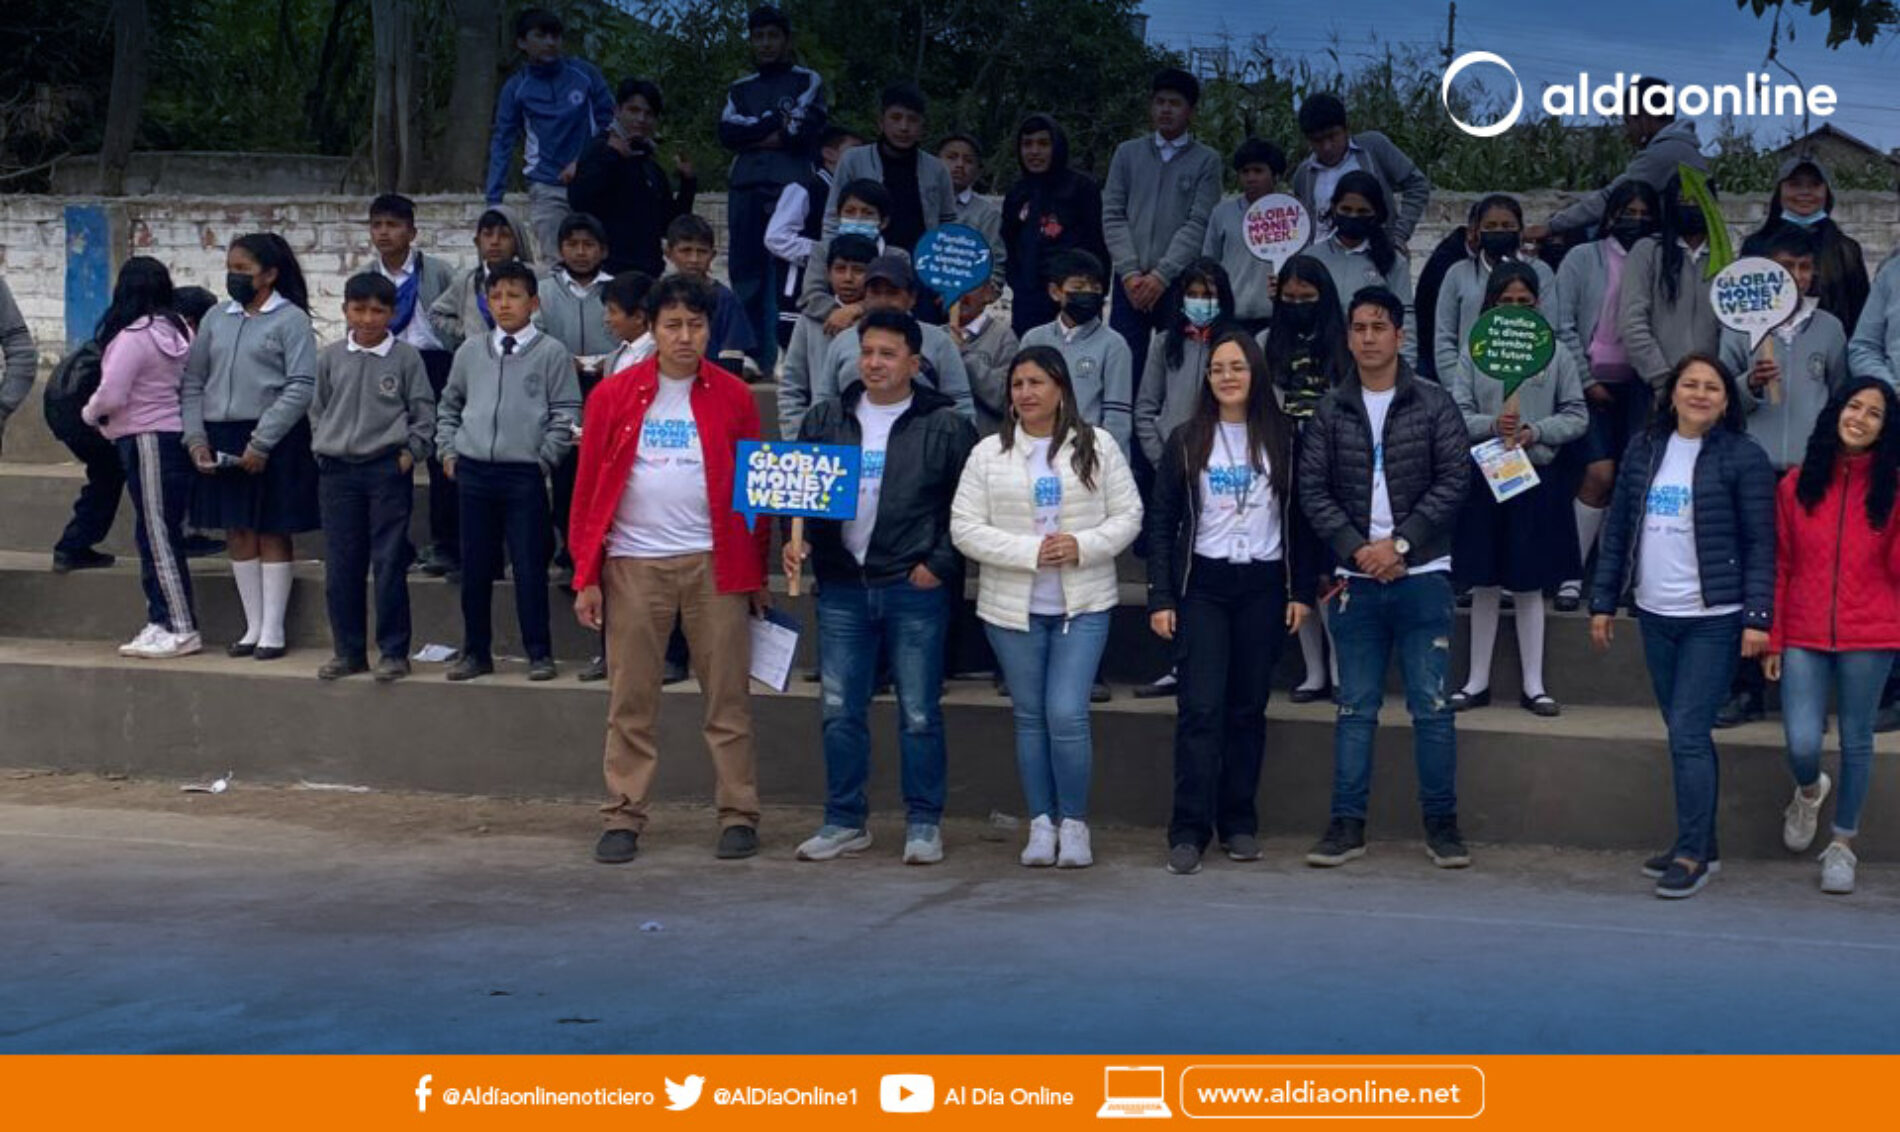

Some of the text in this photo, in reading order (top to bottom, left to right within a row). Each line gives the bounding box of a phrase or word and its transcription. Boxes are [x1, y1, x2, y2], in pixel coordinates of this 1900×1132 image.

[1247, 205, 1300, 223] GLOBAL
[1247, 219, 1297, 233] MONEY
[1716, 270, 1785, 290] GLOBAL
[1717, 284, 1784, 302] MONEY
[1718, 298, 1772, 315] WEEK
[1493, 315, 1537, 330] Planifica
[748, 450, 848, 476] GLOBAL
[746, 470, 837, 493] MONEY
